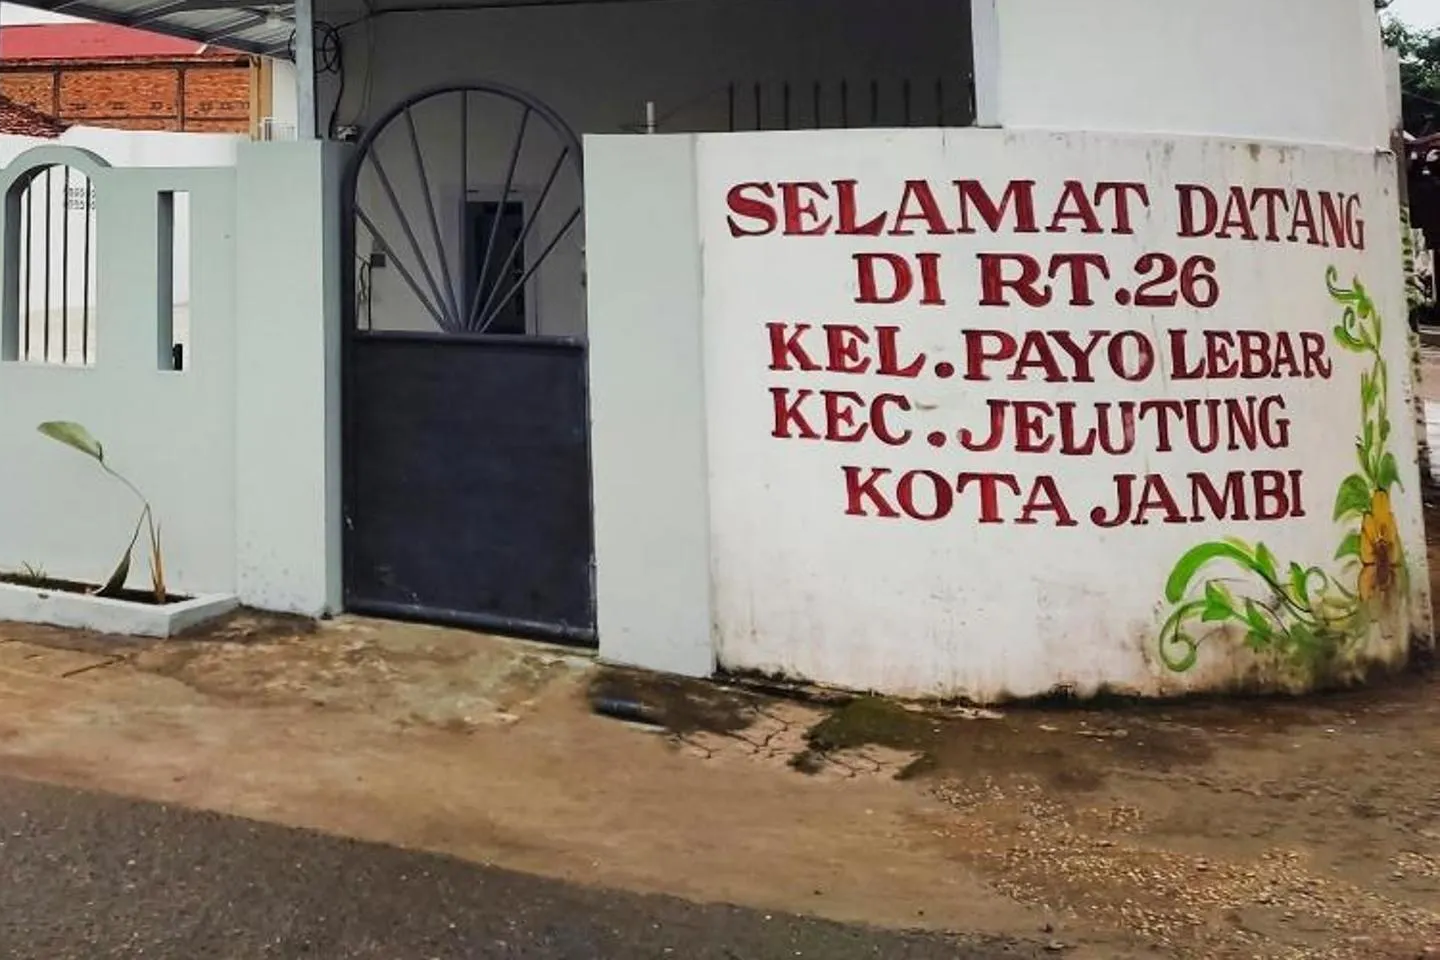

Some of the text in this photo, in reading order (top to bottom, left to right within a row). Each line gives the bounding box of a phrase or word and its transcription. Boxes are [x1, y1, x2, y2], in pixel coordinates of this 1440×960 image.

[726, 179, 1365, 250] SELAMAT DATANG
[852, 252, 945, 306] DI
[1167, 328, 1333, 381] LEBAR
[841, 465, 1305, 528] KOTA JAMBI
